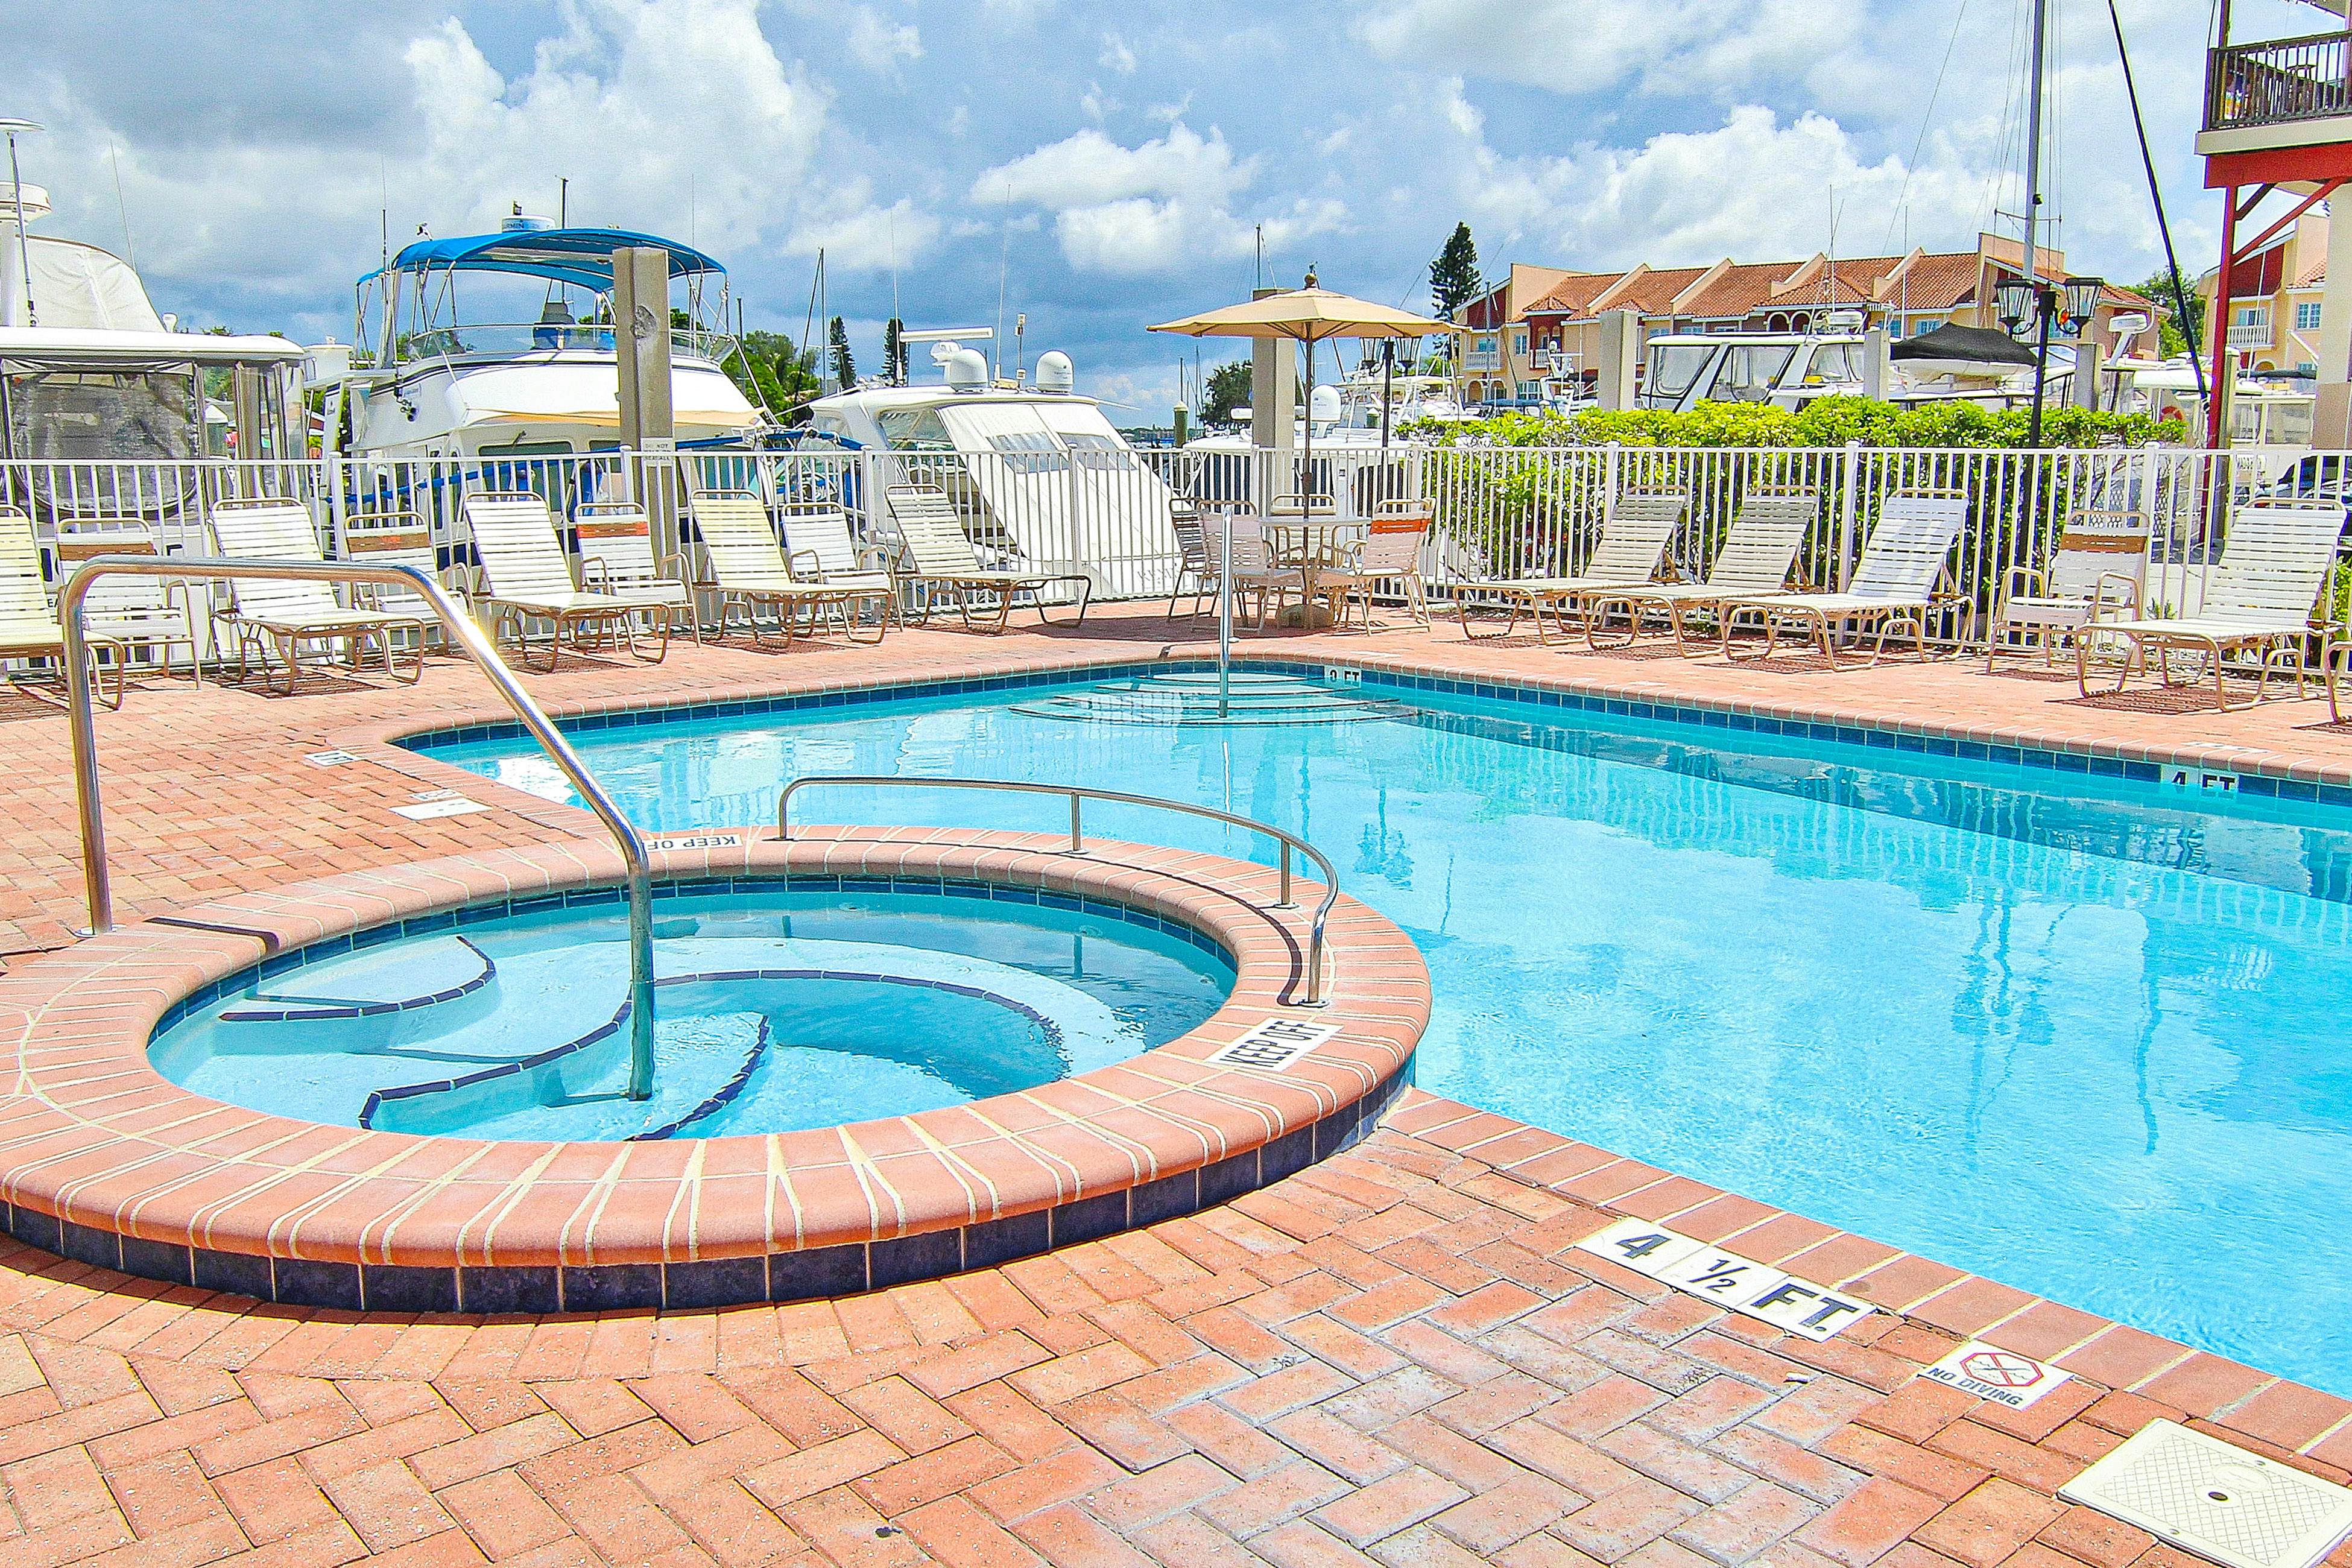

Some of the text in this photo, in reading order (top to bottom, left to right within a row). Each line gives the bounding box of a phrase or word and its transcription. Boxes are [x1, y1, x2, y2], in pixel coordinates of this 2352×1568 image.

[2202, 774, 2236, 791] FT
[647, 836, 736, 850] KEEP OF
[1219, 1020, 1326, 1067] KEEP OFF
[1615, 1234, 1672, 1259] 4
[1750, 1283, 1860, 1332] FT.
[1927, 1367, 2024, 1406] NO DIVING
